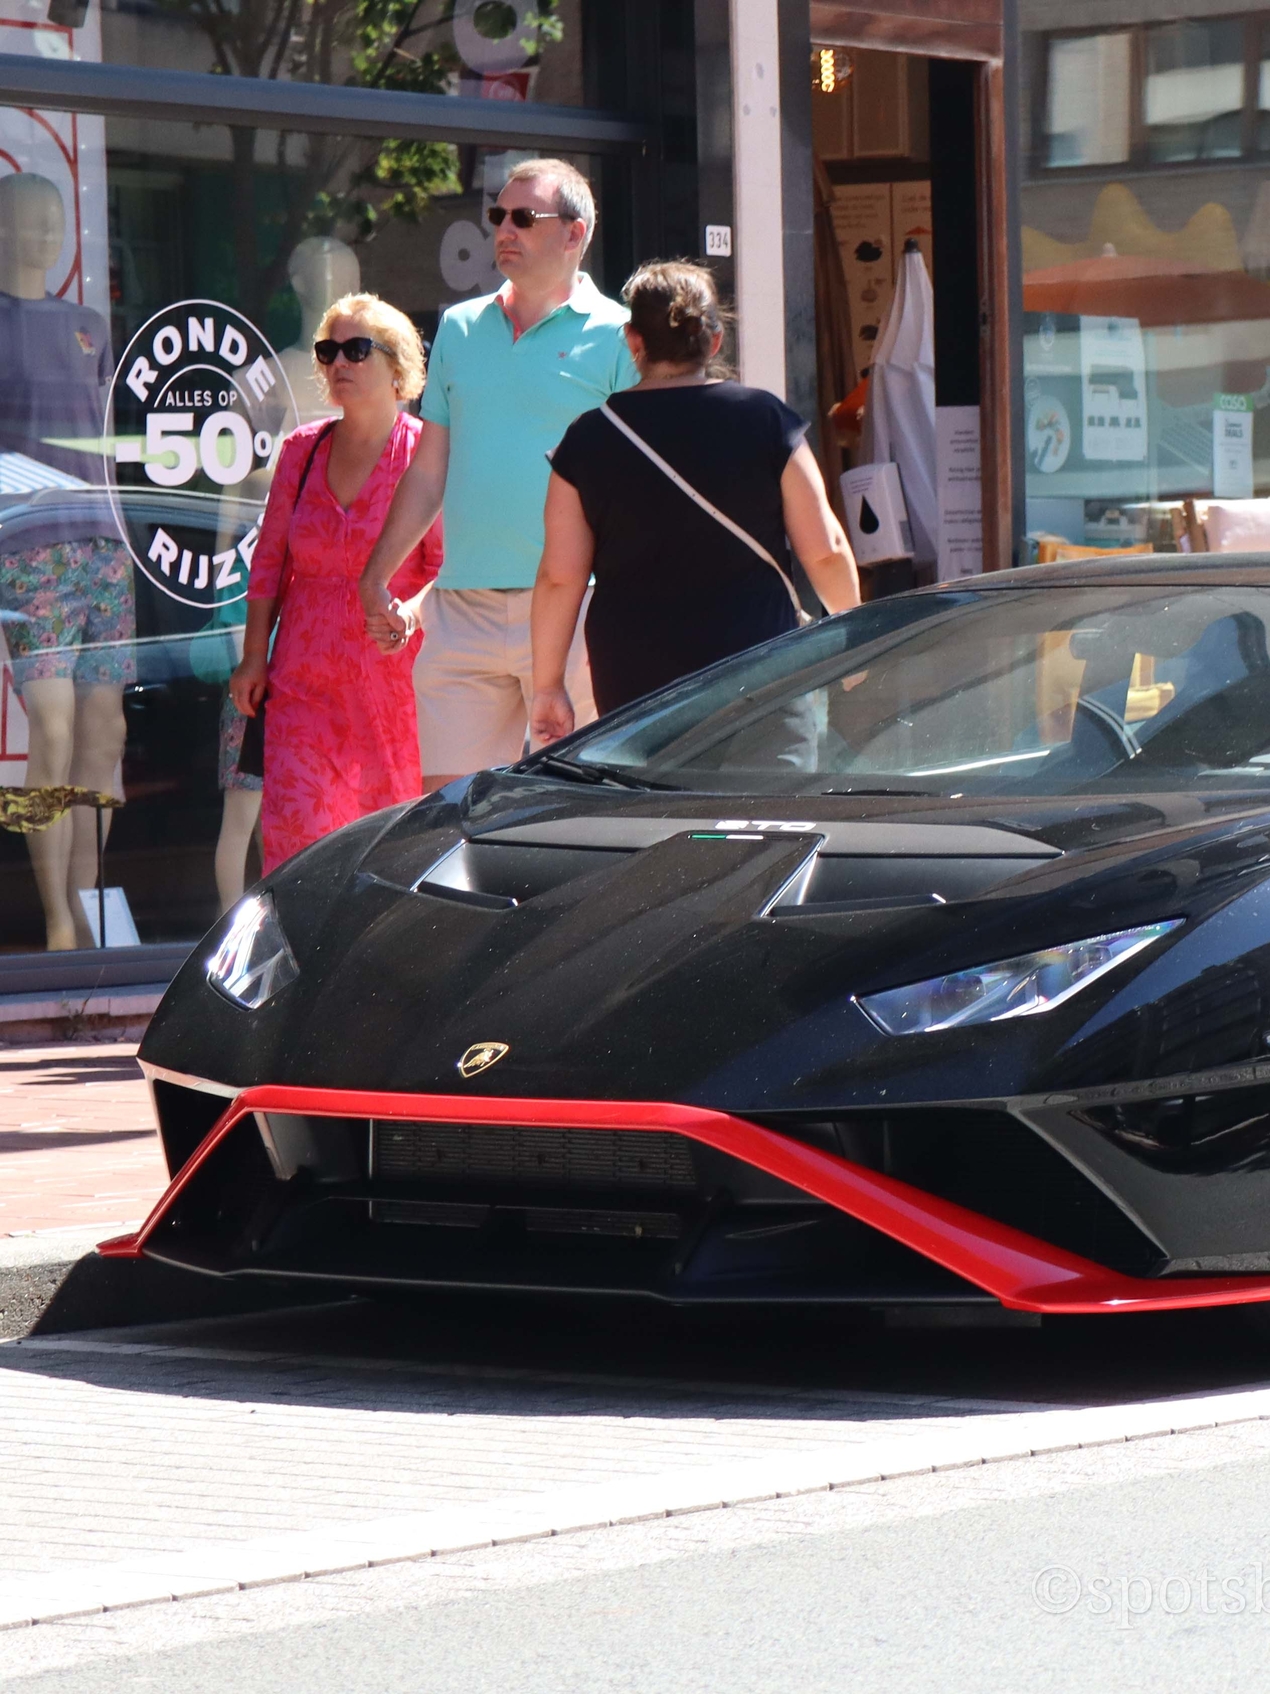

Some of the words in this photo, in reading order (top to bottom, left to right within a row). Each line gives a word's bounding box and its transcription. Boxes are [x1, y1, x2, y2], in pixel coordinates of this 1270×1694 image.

[709, 231, 728, 249] 334
[126, 316, 276, 403] RONDE
[165, 391, 212, 407] ALLES
[218, 390, 238, 406] OP
[147, 513, 264, 590] RIJZE
[715, 820, 817, 831] STO
